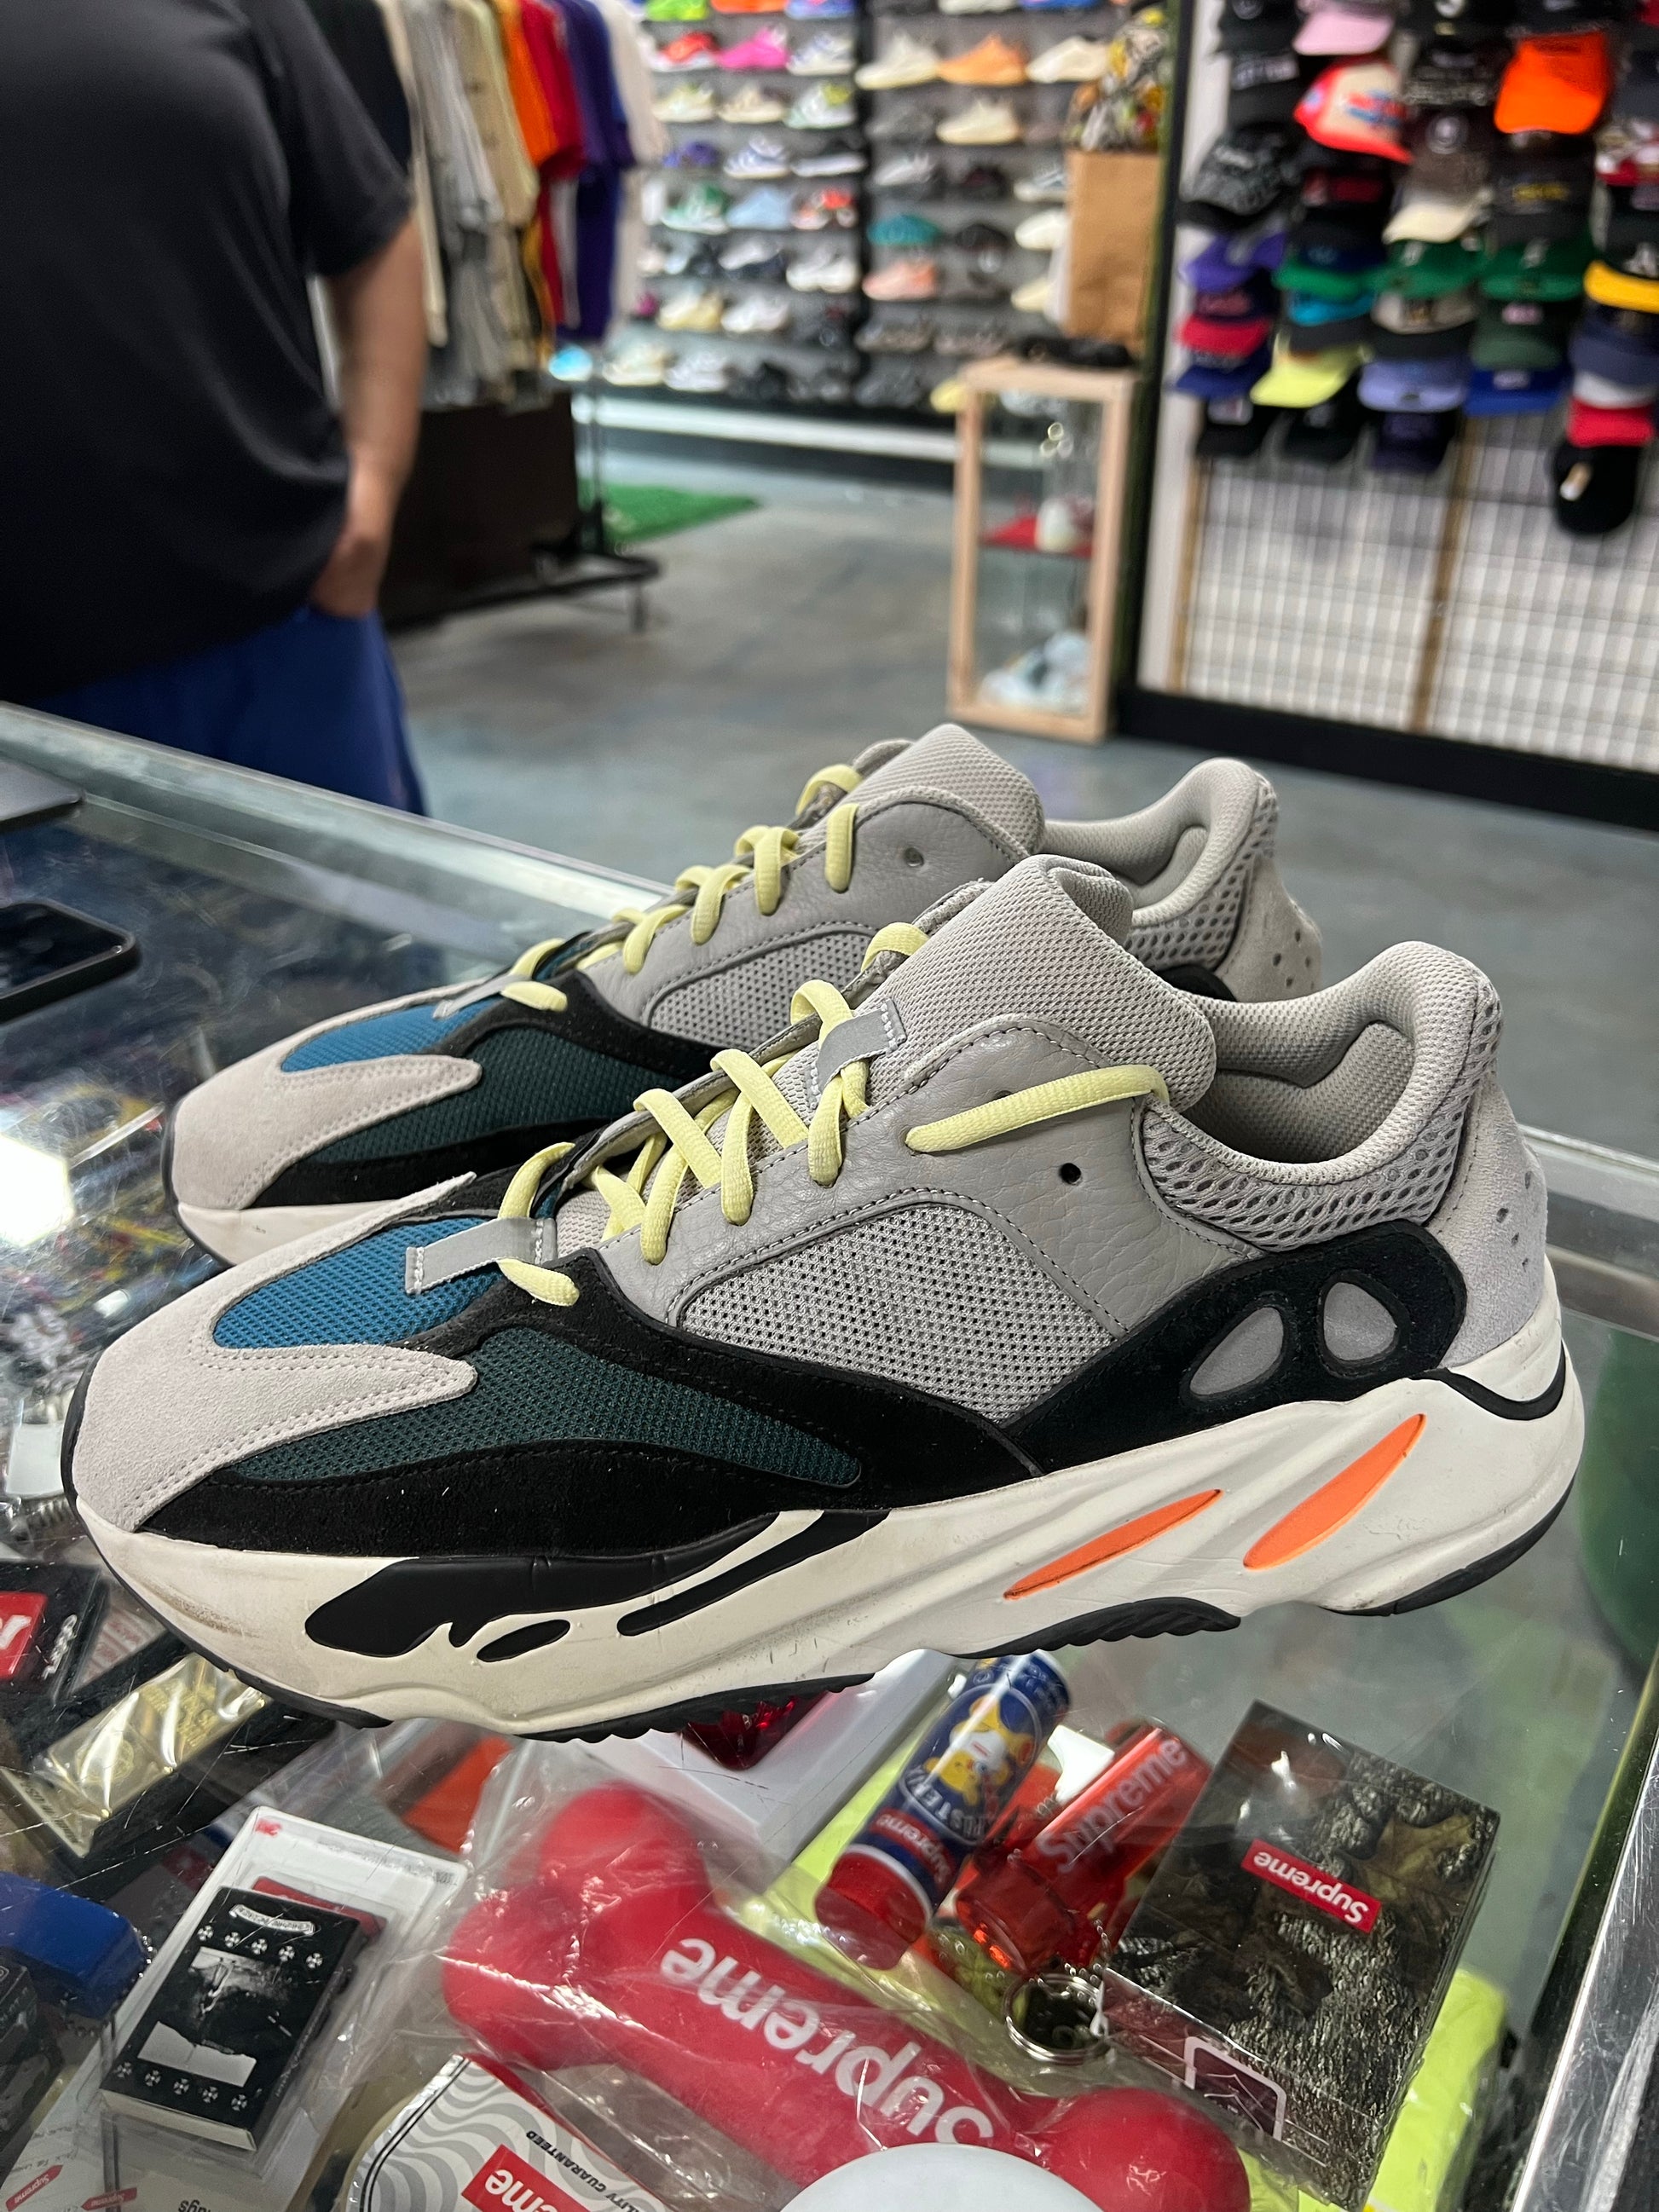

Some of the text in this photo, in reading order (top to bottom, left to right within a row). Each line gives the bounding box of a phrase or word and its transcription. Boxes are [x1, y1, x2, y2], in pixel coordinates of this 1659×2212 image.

[1034, 1740, 1188, 1874] Supreme
[876, 1813, 951, 1886] Supreme
[1252, 1851, 1369, 1923] Supreme
[14, 2174, 50, 2204] Supreme
[526, 2130, 607, 2193] GUARANTEED
